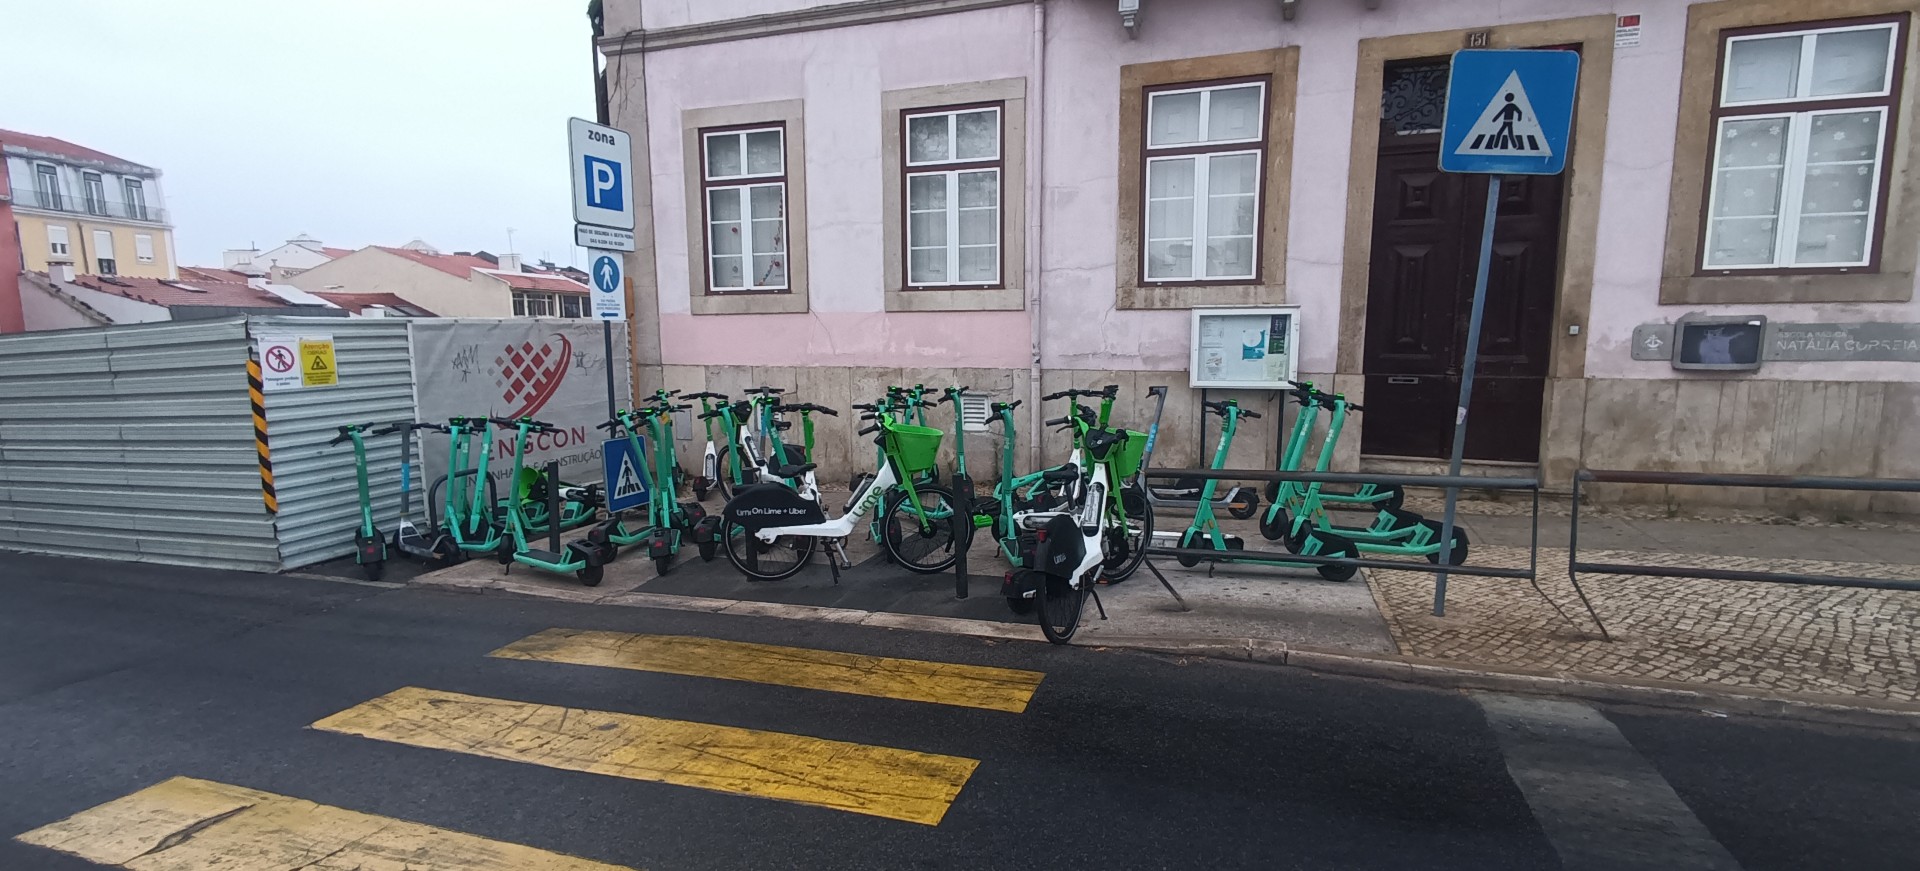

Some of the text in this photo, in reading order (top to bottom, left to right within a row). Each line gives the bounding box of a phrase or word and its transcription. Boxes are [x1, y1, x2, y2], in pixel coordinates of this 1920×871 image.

[1471, 33, 1486, 47] 151
[588, 130, 615, 146] zona
[592, 161, 615, 204] P
[1777, 336, 1840, 351] NATÁLIA
[541, 448, 602, 471] CNSTRUÇÃO
[852, 485, 883, 517] Lime
[751, 507, 763, 515] On
[764, 507, 781, 515] Lime
[789, 507, 806, 515] Uber
